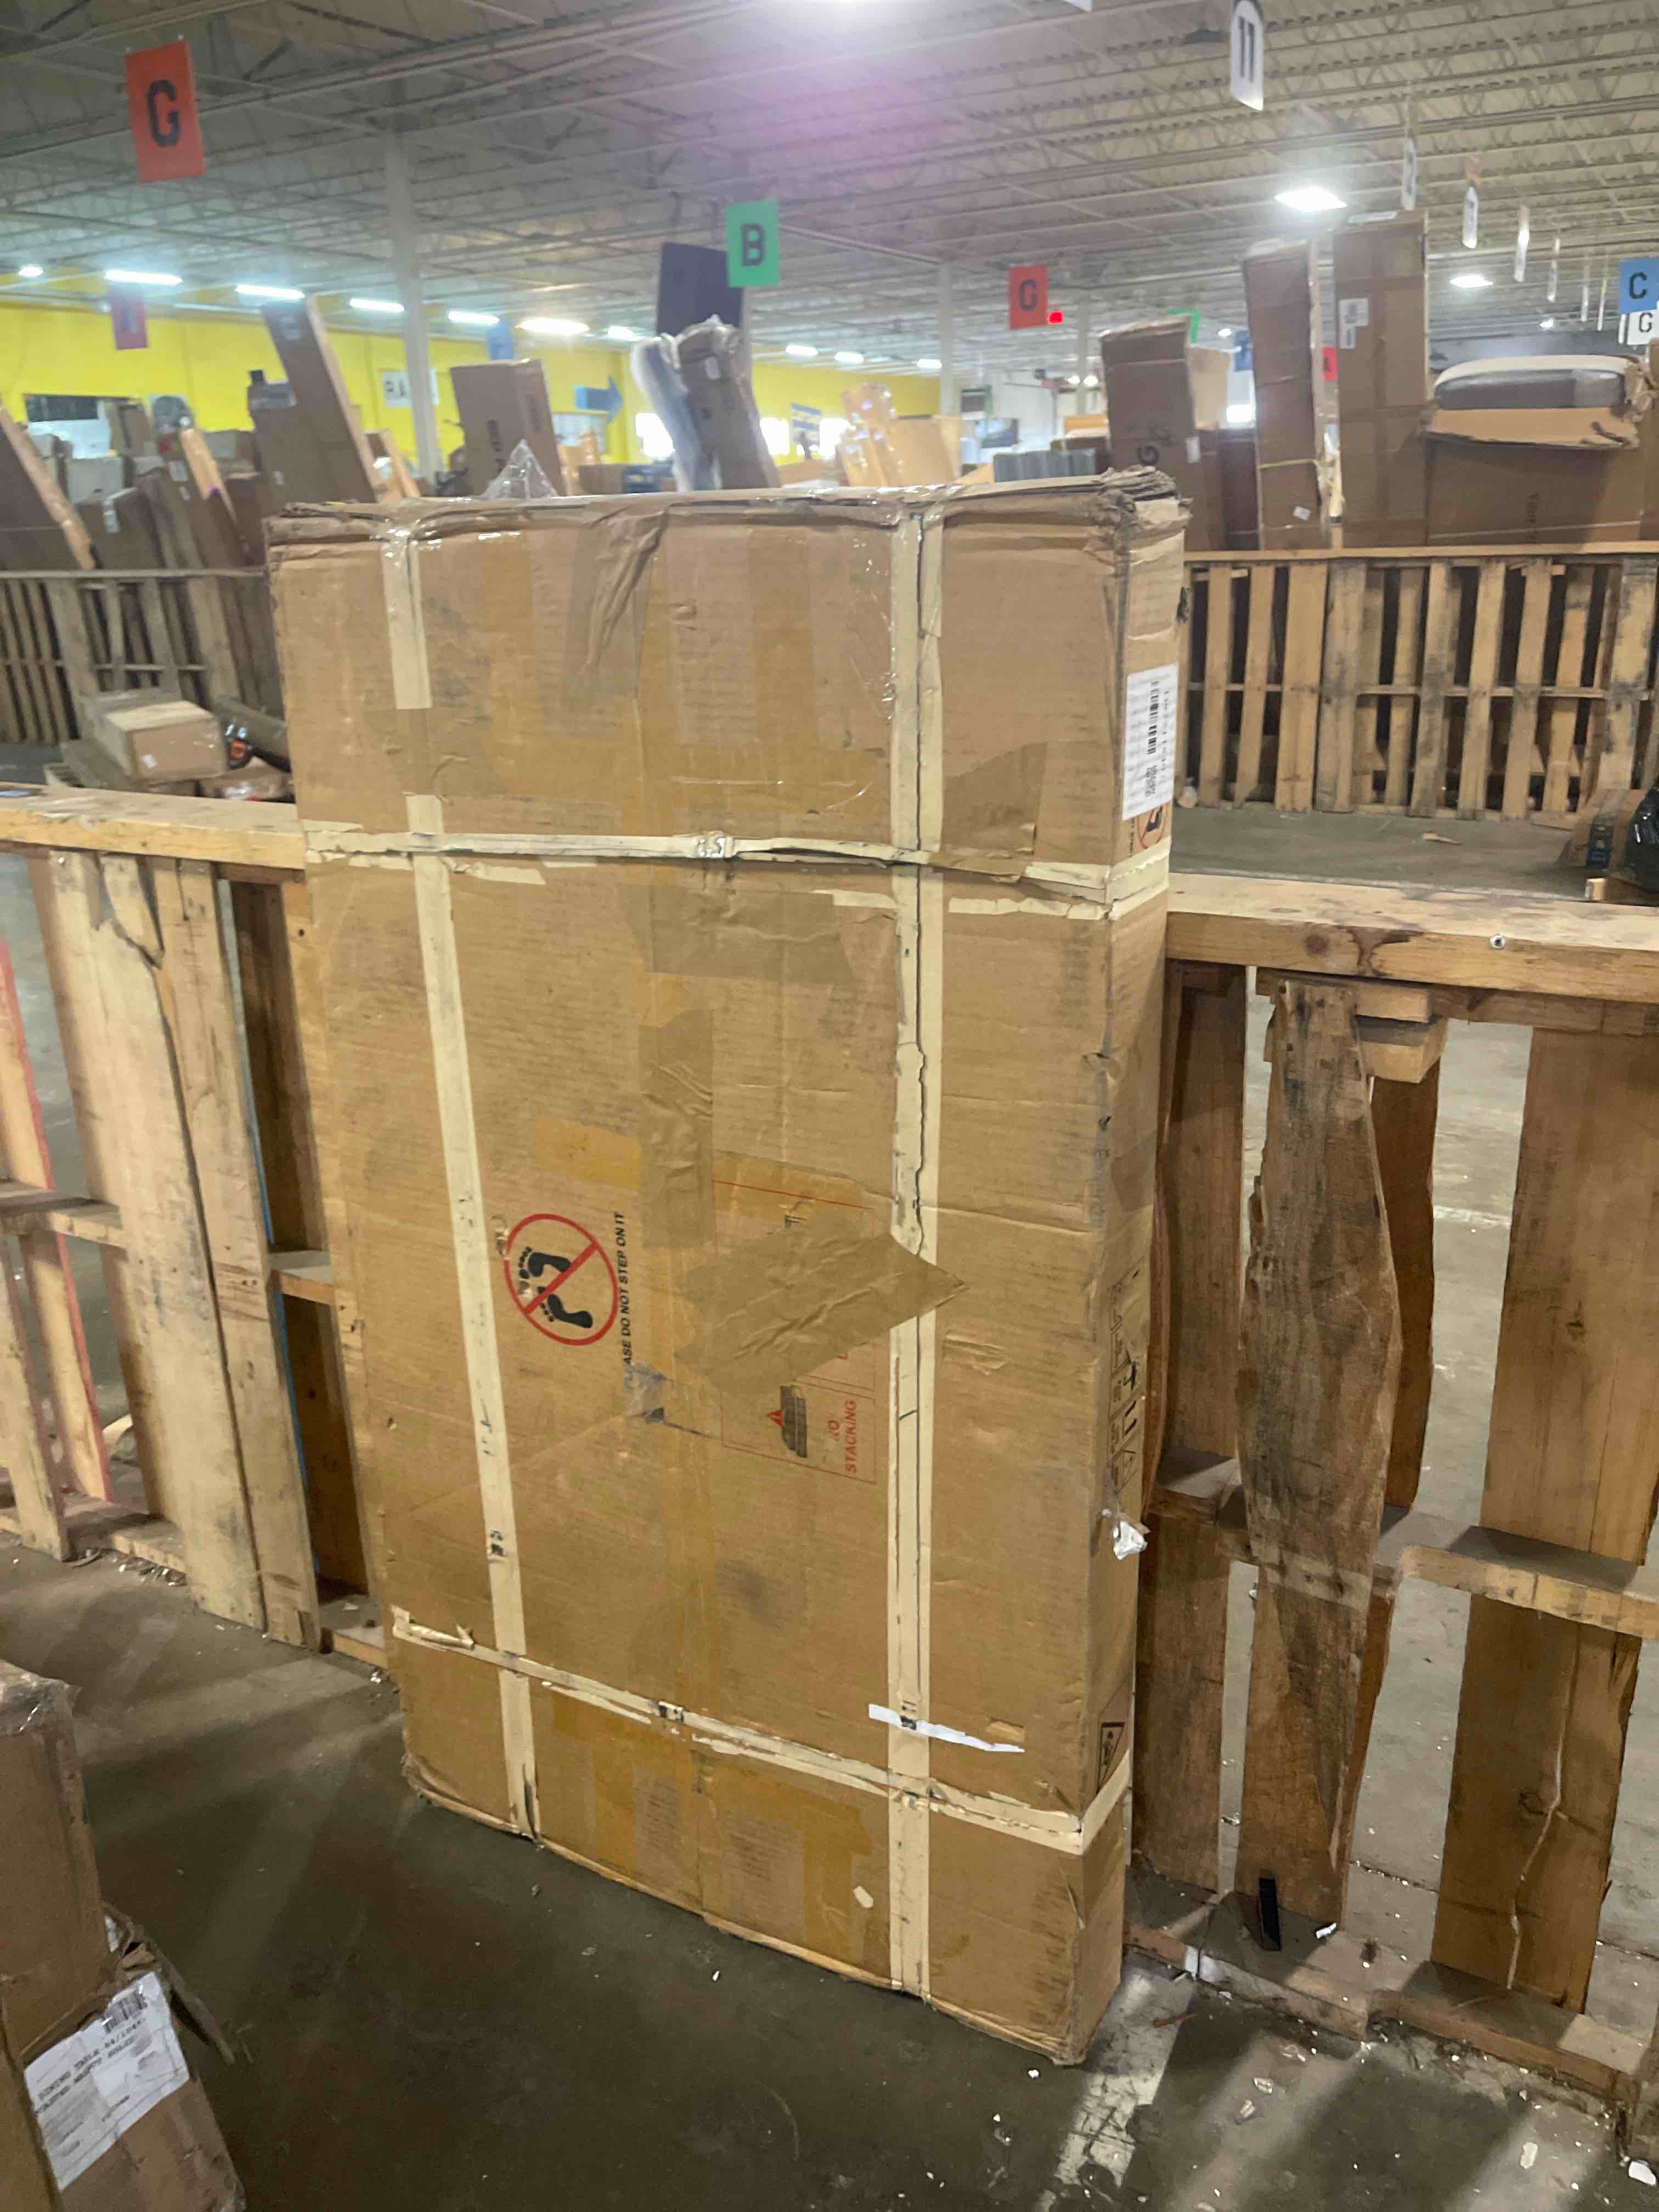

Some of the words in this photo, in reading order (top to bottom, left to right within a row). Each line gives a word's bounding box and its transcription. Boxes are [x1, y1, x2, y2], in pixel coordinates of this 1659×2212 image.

[146, 79, 180, 148] G
[741, 223, 764, 267] B
[1629, 272, 1647, 299] C
[1639, 312, 1653, 333] G
[614, 1211, 624, 1224] IT
[615, 1227, 627, 1247] ON
[617, 1250, 628, 1285] STEP
[618, 1287, 630, 1314] NOT
[620, 1318, 631, 1337] DO
[844, 1400, 857, 1475] STACKING
